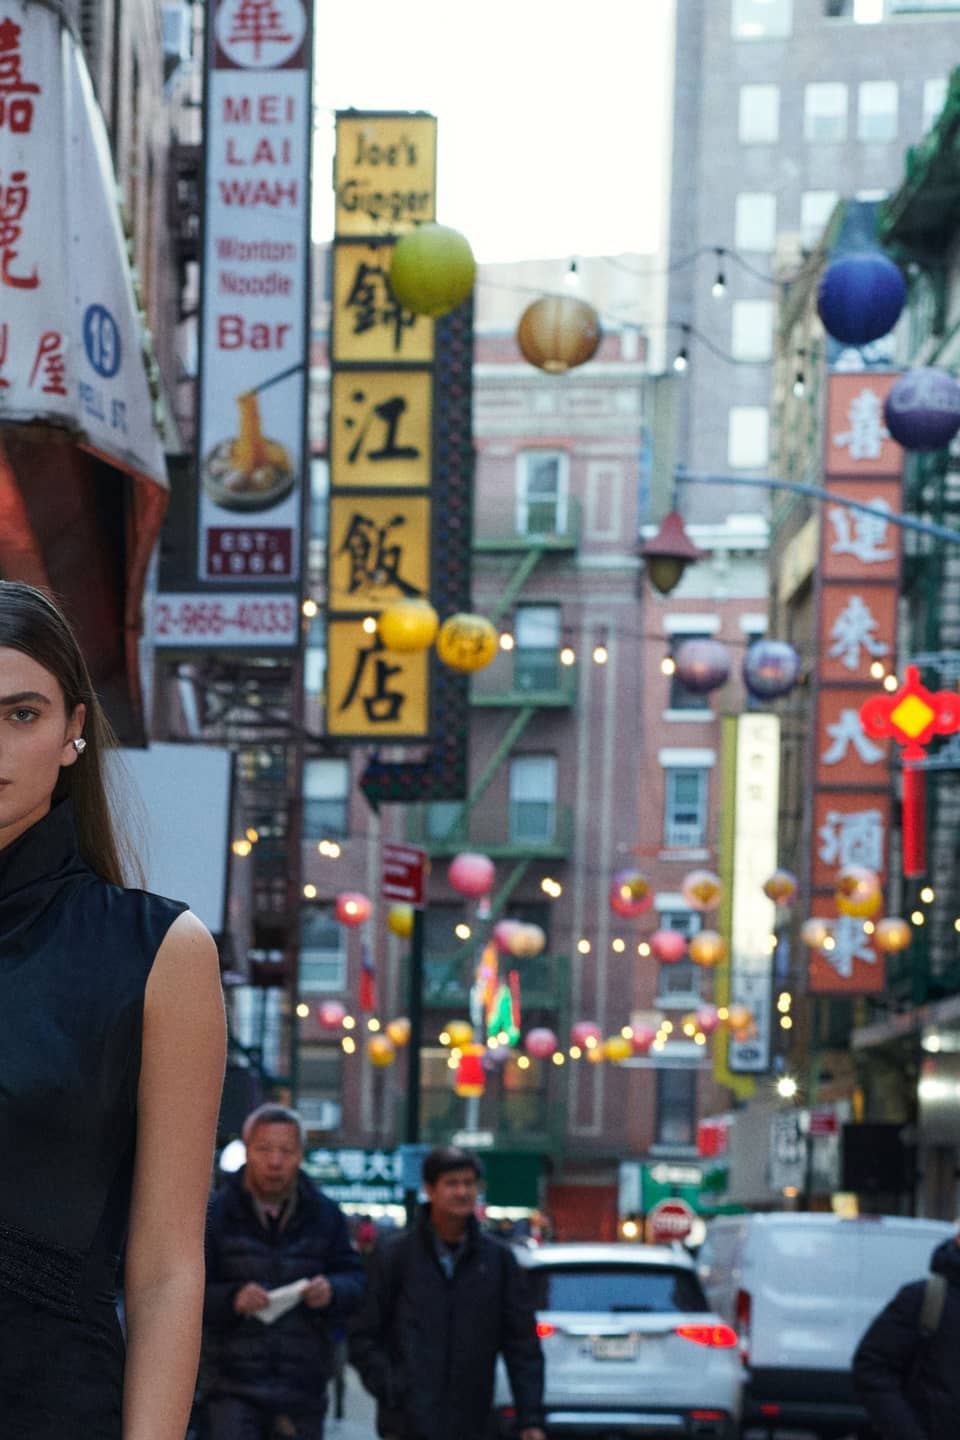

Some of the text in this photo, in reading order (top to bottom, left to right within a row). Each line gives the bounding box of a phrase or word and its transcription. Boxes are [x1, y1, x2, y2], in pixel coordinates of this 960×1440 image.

[223, 96, 295, 123] MEI
[225, 138, 291, 166] LAI
[218, 180, 297, 208] WAH
[216, 239, 295, 262] Wonton
[218, 273, 291, 297] Noodle
[216, 315, 291, 351] Bar
